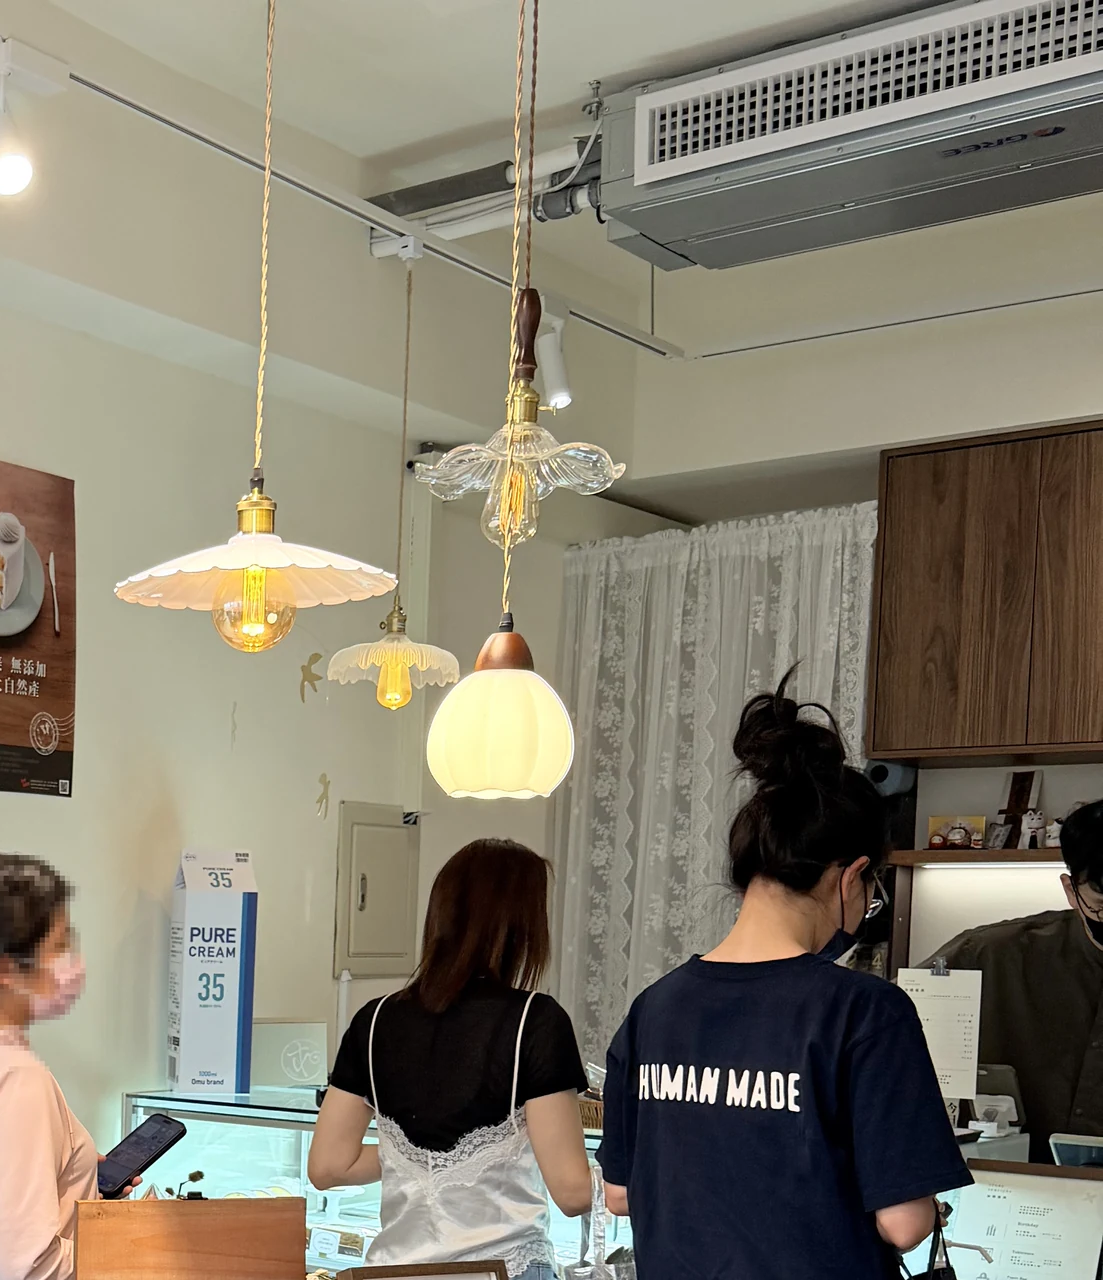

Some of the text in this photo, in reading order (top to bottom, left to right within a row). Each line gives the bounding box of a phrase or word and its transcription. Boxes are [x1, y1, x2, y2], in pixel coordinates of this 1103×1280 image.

[941, 133, 1028, 158] GREE
[10, 656, 47, 678] 無添加
[208, 871, 233, 889] 35
[189, 926, 237, 944] PURE
[188, 945, 236, 958] CREAM
[197, 972, 225, 1002] 35
[206, 1078, 225, 1086] brand
[639, 1063, 801, 1113] HUMAN MADE
